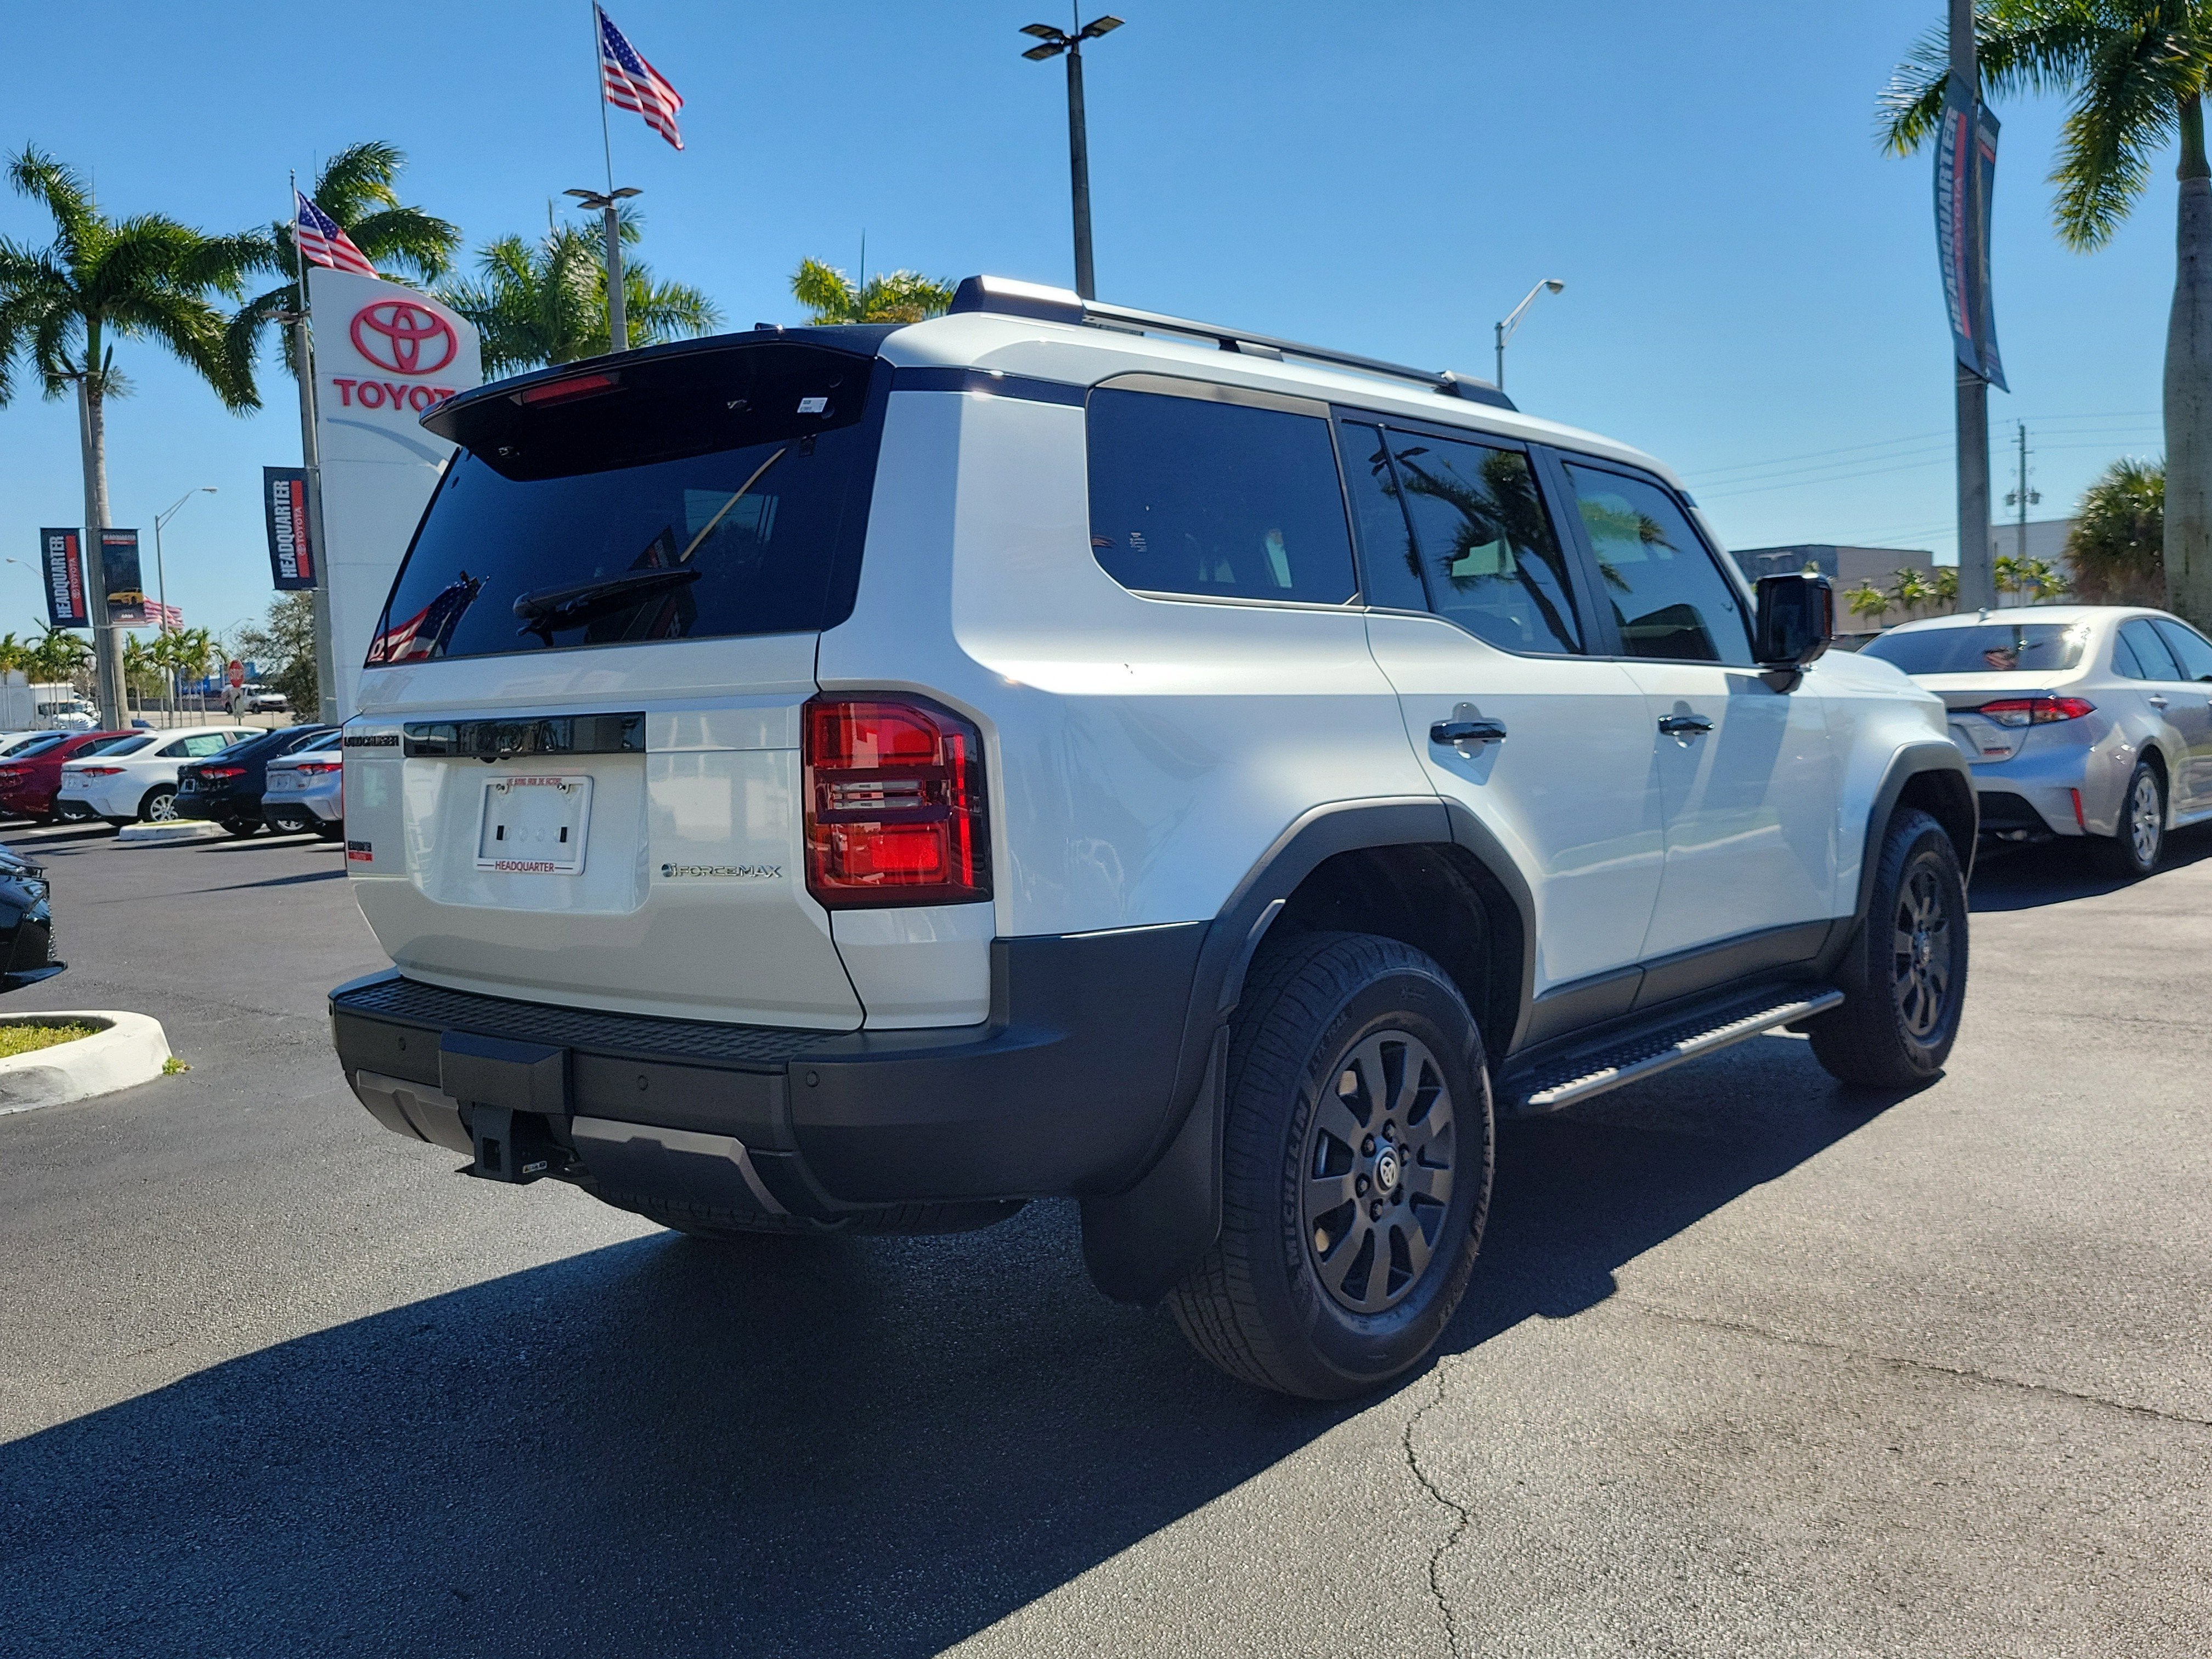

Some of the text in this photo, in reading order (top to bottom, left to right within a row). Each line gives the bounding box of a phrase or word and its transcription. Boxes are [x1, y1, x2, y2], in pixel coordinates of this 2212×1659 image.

[1938, 105, 1965, 336] HEADQUARTER
[334, 379, 455, 413] TOYO
[273, 480, 298, 578] HEADQUARTER
[294, 506, 304, 544] TOYOTA
[49, 535, 73, 619] HEADQUARTER
[68, 557, 81, 589] TOYOTA
[495, 860, 555, 873] HEADQUARTER
[1284, 1099, 1309, 1266] MICHELIN
